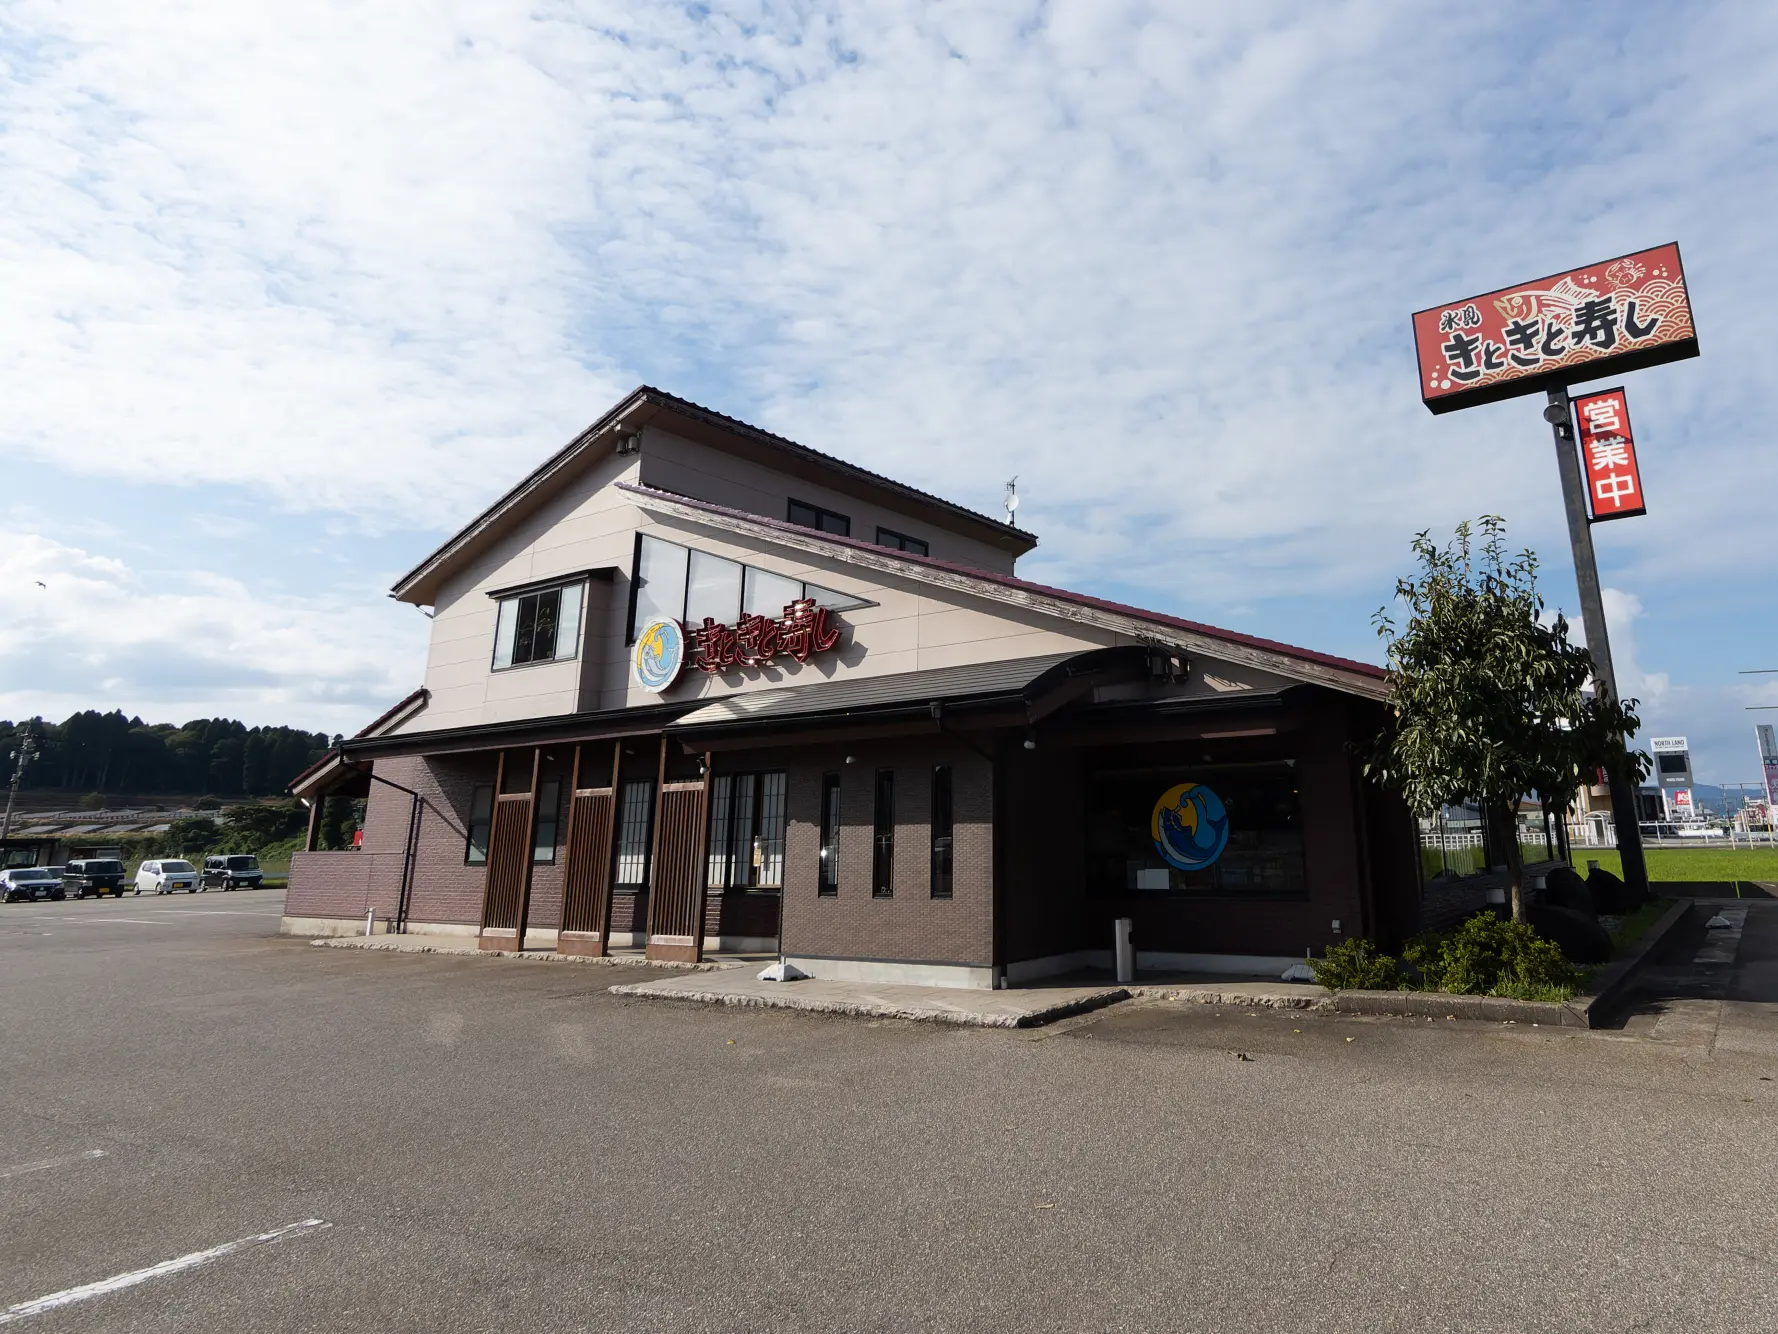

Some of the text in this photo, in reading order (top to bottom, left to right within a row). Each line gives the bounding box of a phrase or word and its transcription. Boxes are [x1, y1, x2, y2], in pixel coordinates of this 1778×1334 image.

[1440, 304, 1482, 332] 氷見
[1443, 296, 1661, 381] きときと寿し
[1583, 398, 1635, 508] 営業中
[695, 598, 842, 673] きときと寿し
